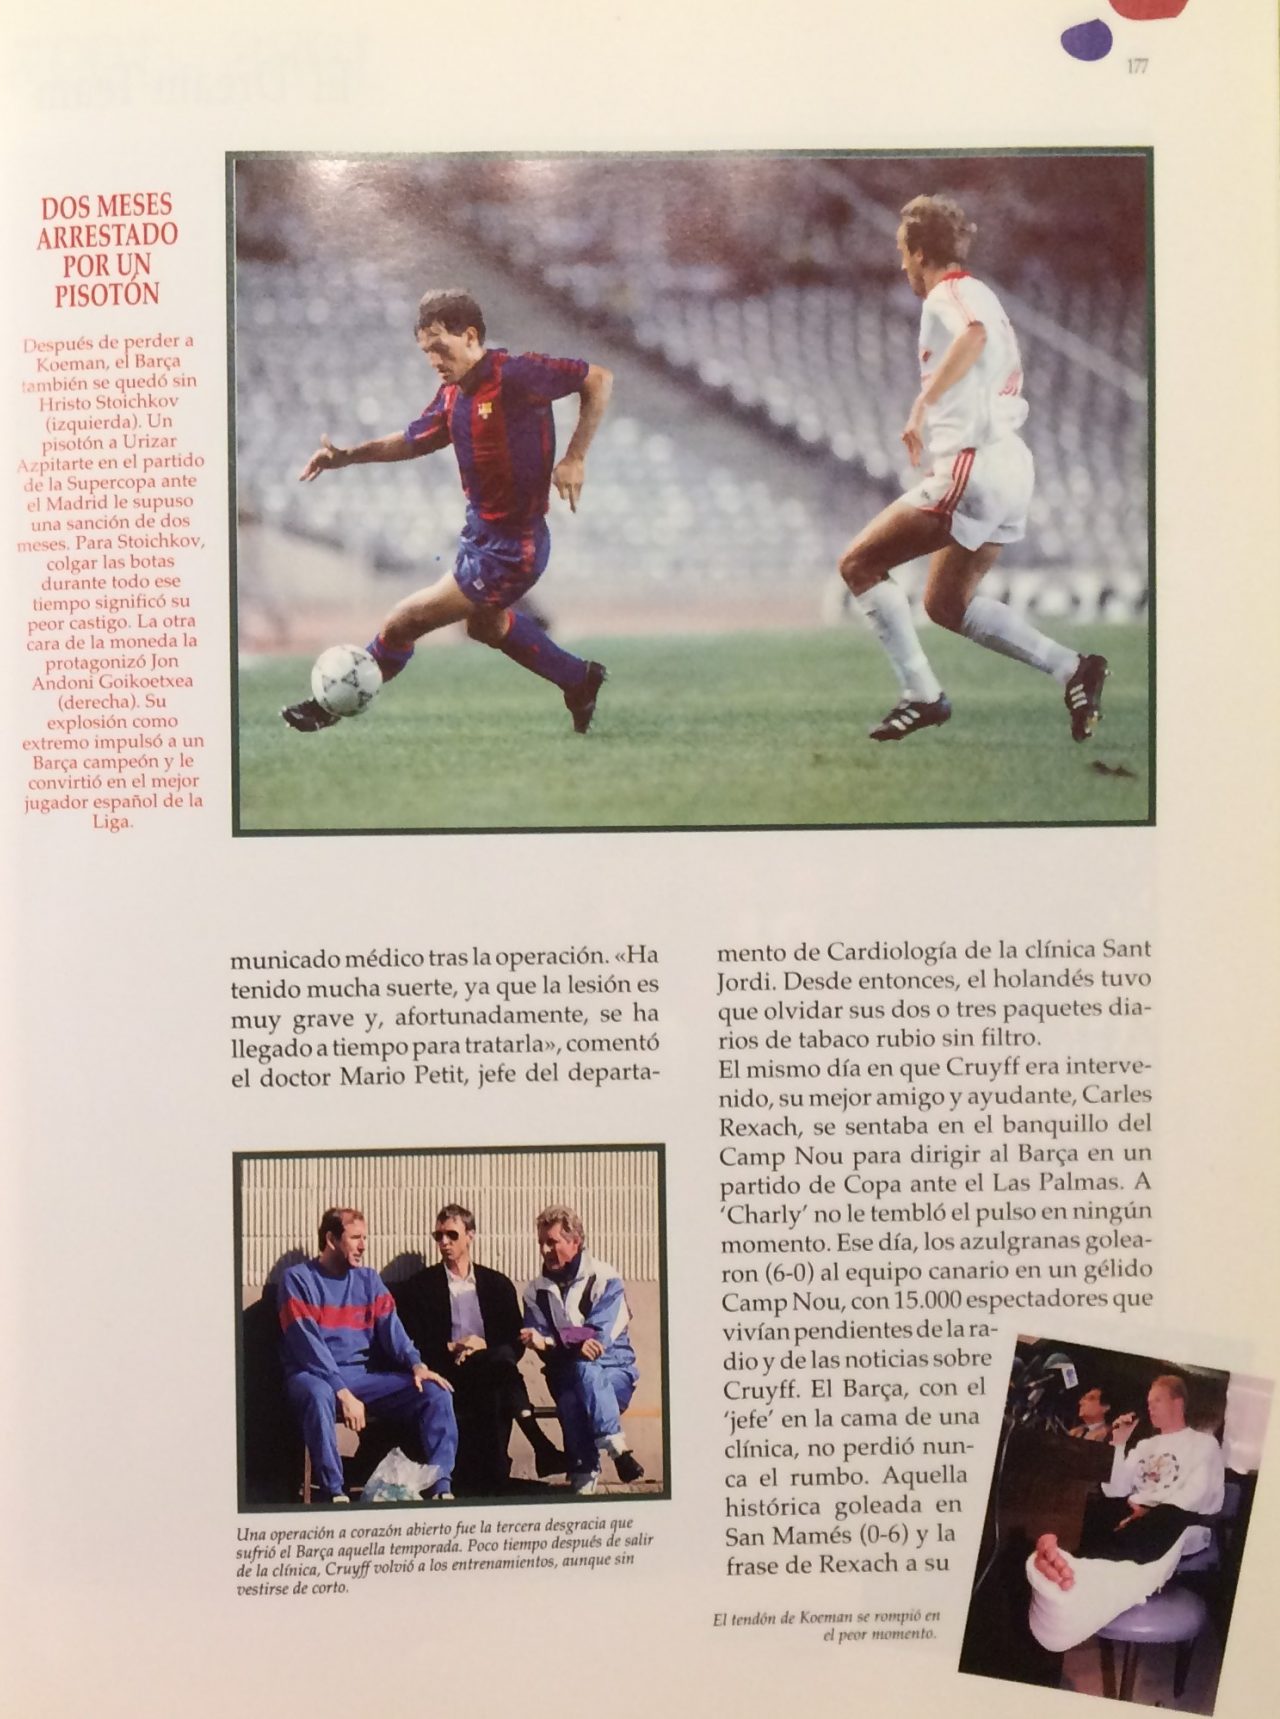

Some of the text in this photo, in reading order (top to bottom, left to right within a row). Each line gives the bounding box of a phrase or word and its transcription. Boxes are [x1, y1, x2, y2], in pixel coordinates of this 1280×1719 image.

[1128, 58, 1149, 74] 177
[42, 192, 173, 220] DOS MESES
[37, 221, 178, 250] ARRESTADO
[63, 252, 152, 278] POR UN
[55, 271, 160, 308] PISOTÓN
[24, 333, 194, 357] Después de perder a
[36, 354, 181, 373] Koeman, el Barça
[22, 372, 197, 393] también se quedó sin
[40, 392, 179, 412] Hristo Stoichkov
[45, 413, 173, 436] (izquierda). Un
[230, 944, 659, 972] municado médico tras la operación. «Ha
[717, 938, 1151, 966] mento de Cardiología de la clínica Sant
[231, 974, 659, 1002] tenido mucha suerte, ya que la lesión es
[231, 1001, 659, 1035] muy grave y, afortunadamente, se ha
[231, 1032, 660, 1065] llegado a tiempo para tratarla», comentó
[231, 1061, 660, 1089] el doctor Mario Petit, jefe del departa-
[725, 1464, 967, 1491] ca el rumbo. Aquella
[725, 1494, 962, 1521] histórica goleada en
[237, 1516, 634, 1547] Una operación a corazón abierto fue la tercera desgracia que
[725, 1523, 955, 1549] San Mamés (0-6) y la
[236, 1532, 654, 1564] sufrió el Barça aquella temporada. Poco tiempo después de salir
[236, 1551, 634, 1579] de la clínica, Cruyff volvió a los entrenamientos, aunque sin
[727, 1552, 949, 1576] frase de Rexach a su
[237, 1580, 349, 1596] vestirse de corto.
[713, 1609, 941, 1627] El tendón de Koeman se rompió en
[823, 1627, 937, 1645] el peor momento.
